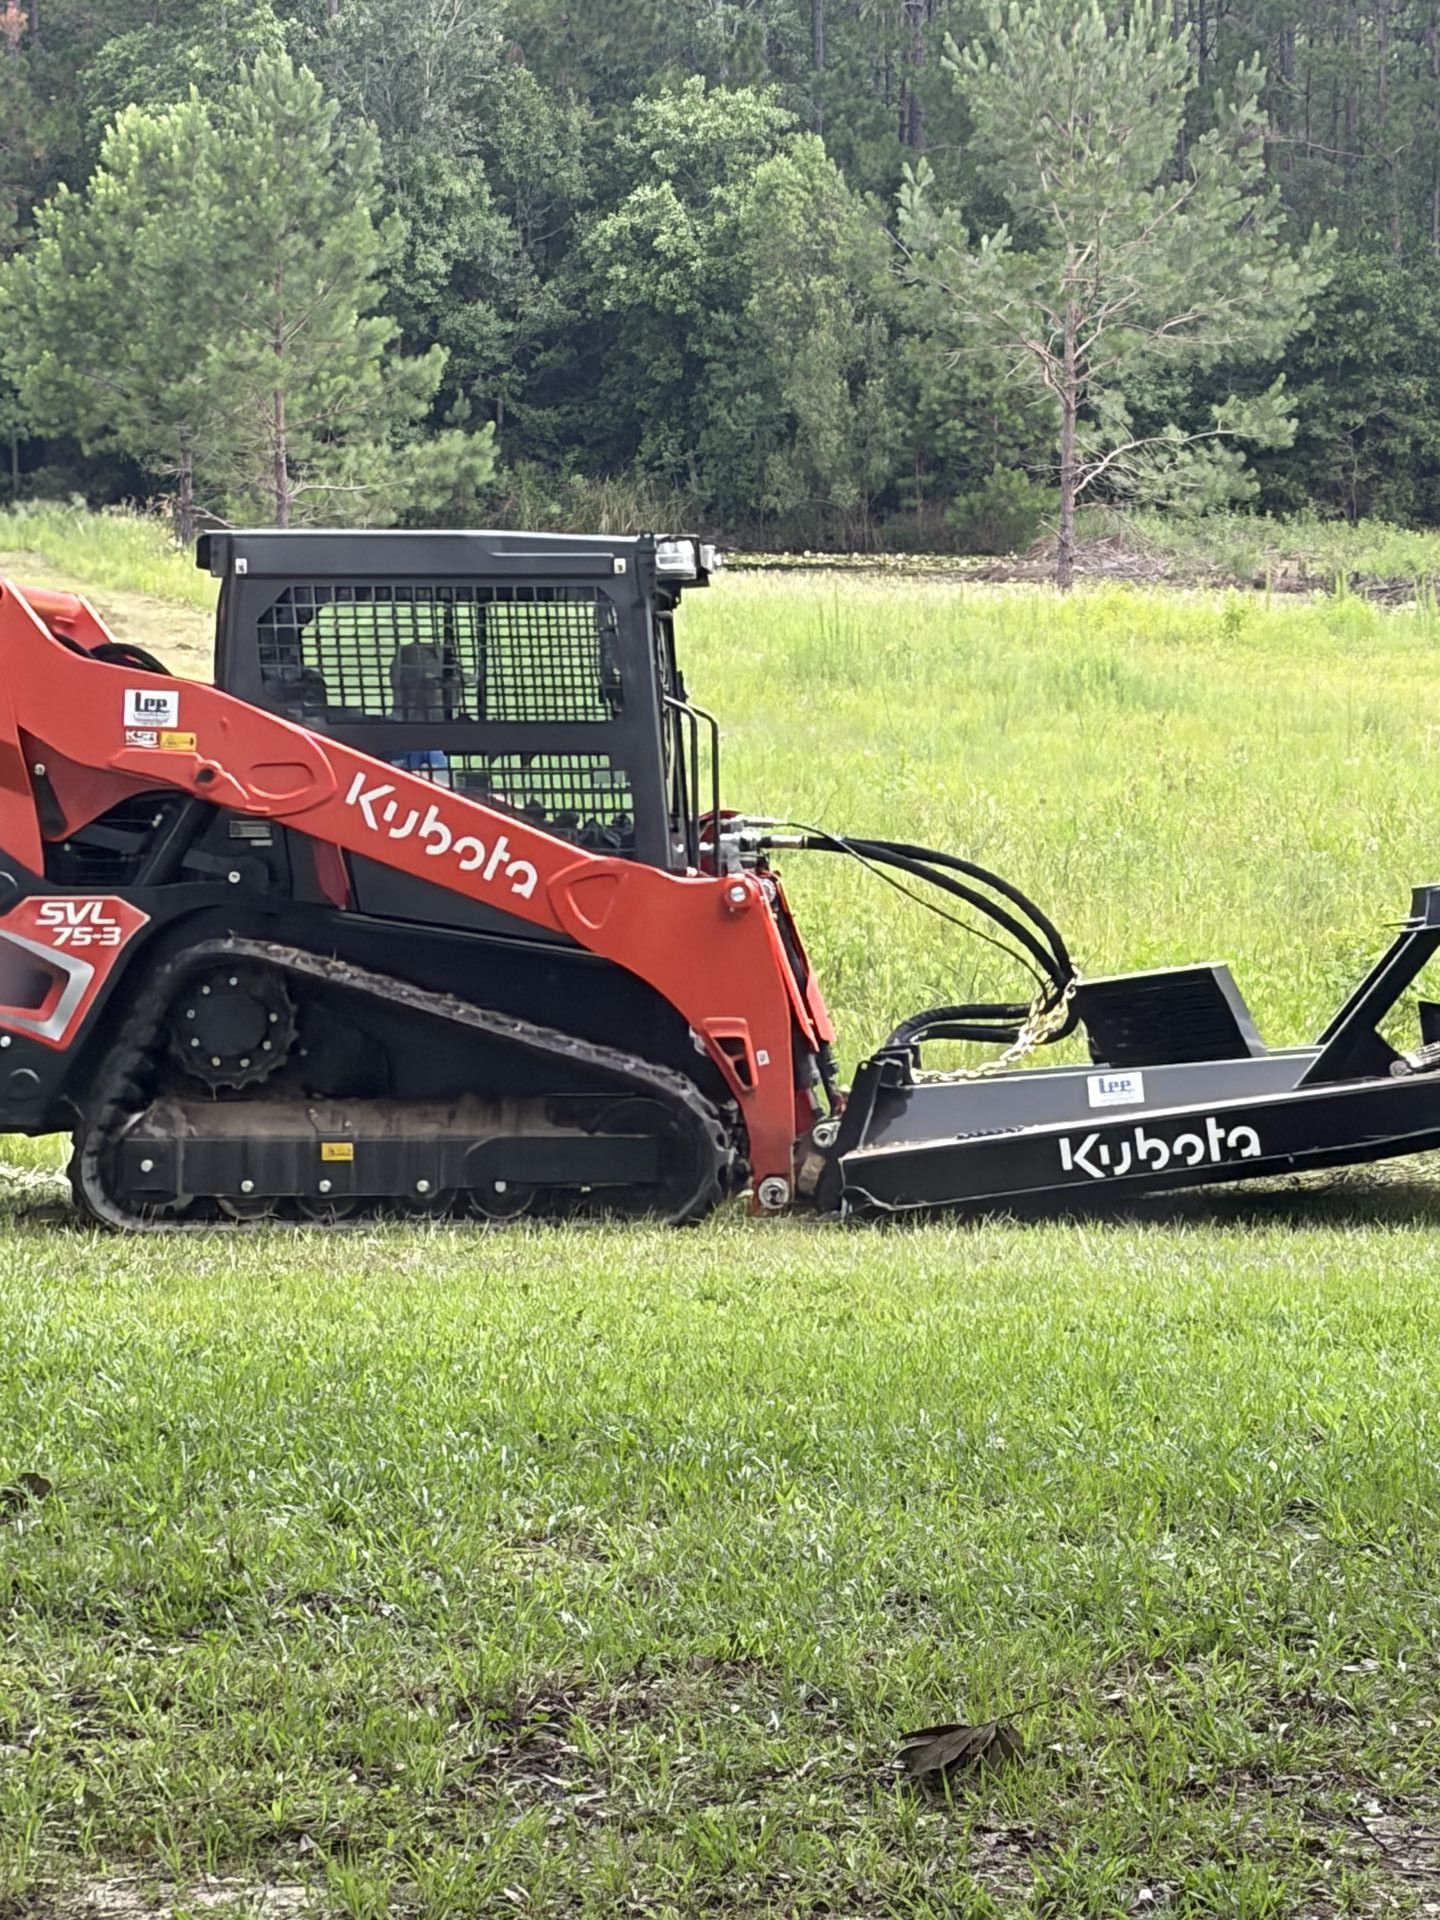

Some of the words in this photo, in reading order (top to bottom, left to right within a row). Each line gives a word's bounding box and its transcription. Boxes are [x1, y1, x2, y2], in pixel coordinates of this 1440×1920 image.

[345, 771, 538, 900] Kubota
[35, 901, 116, 925] SVL
[52, 927, 121, 946] 75-3
[1059, 1117, 1261, 1178] Kubota
